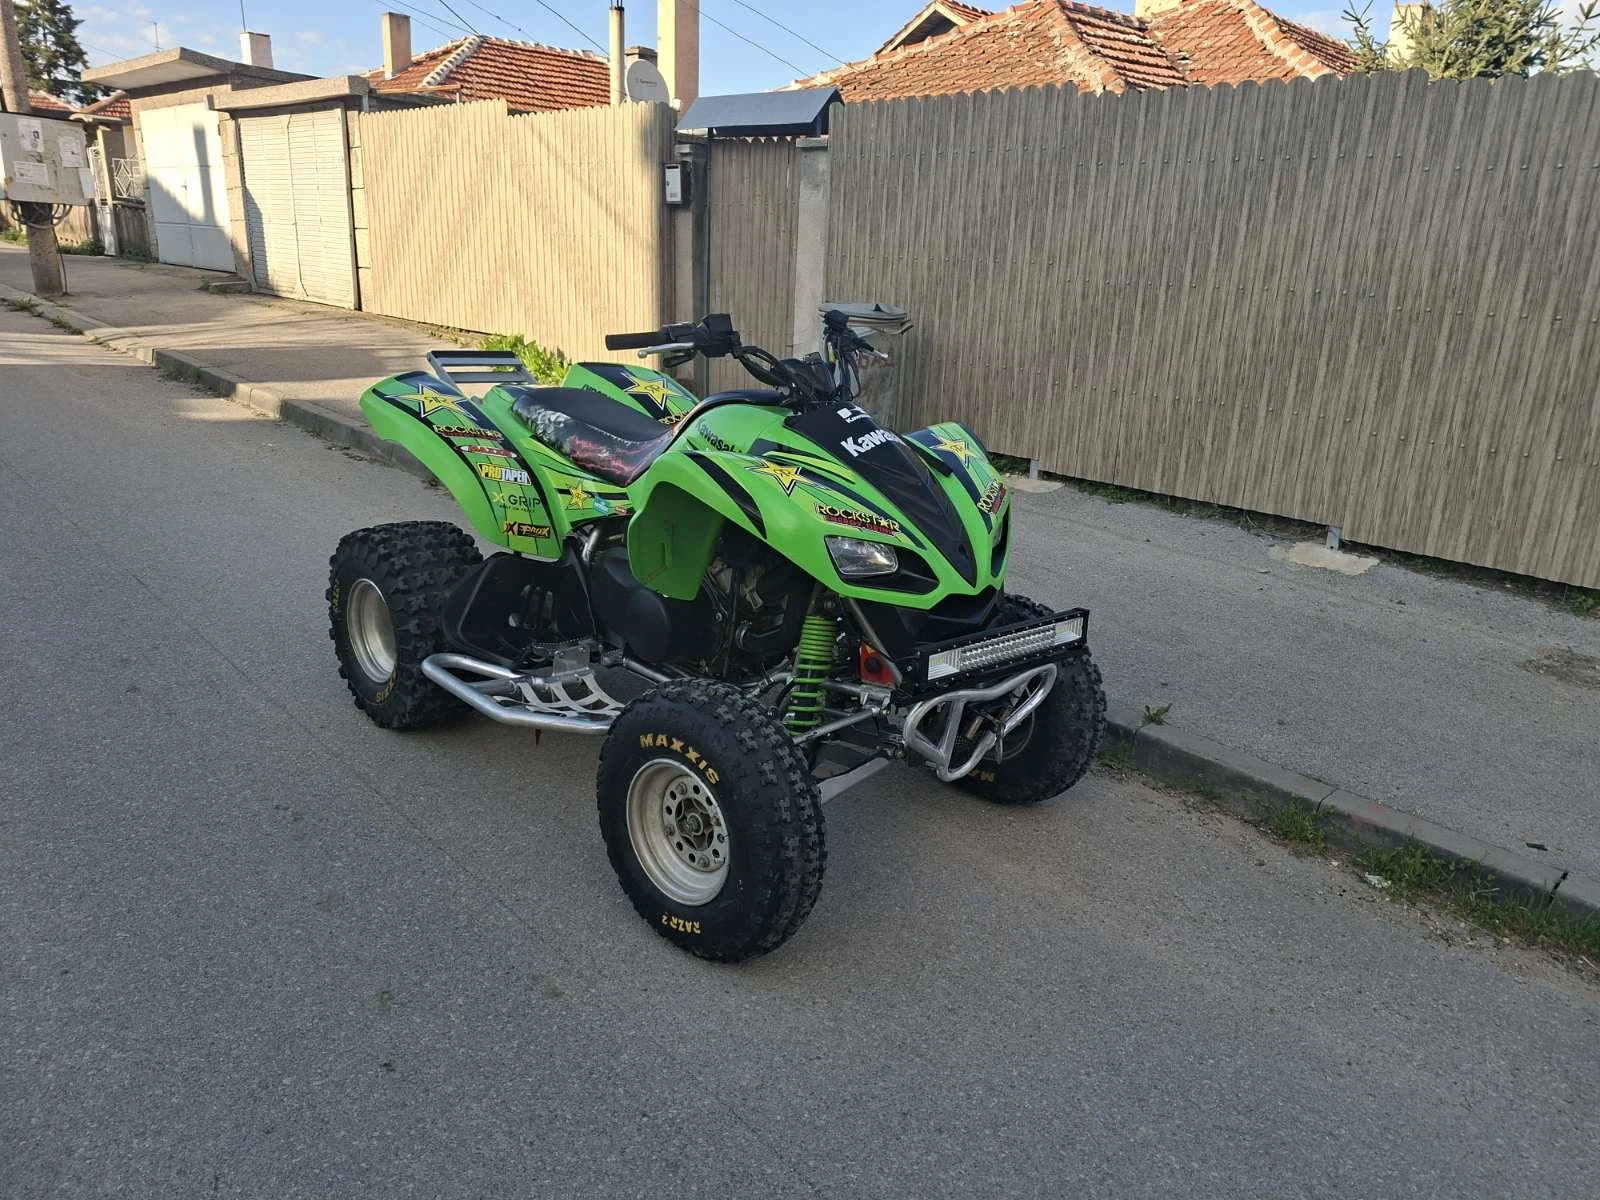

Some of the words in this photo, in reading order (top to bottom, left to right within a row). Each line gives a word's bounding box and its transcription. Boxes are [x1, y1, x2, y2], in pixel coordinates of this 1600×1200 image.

[508, 494, 542, 509] GRIP
[815, 502, 900, 533] ROCKSTAR
[639, 732, 720, 785] MAXXIS
